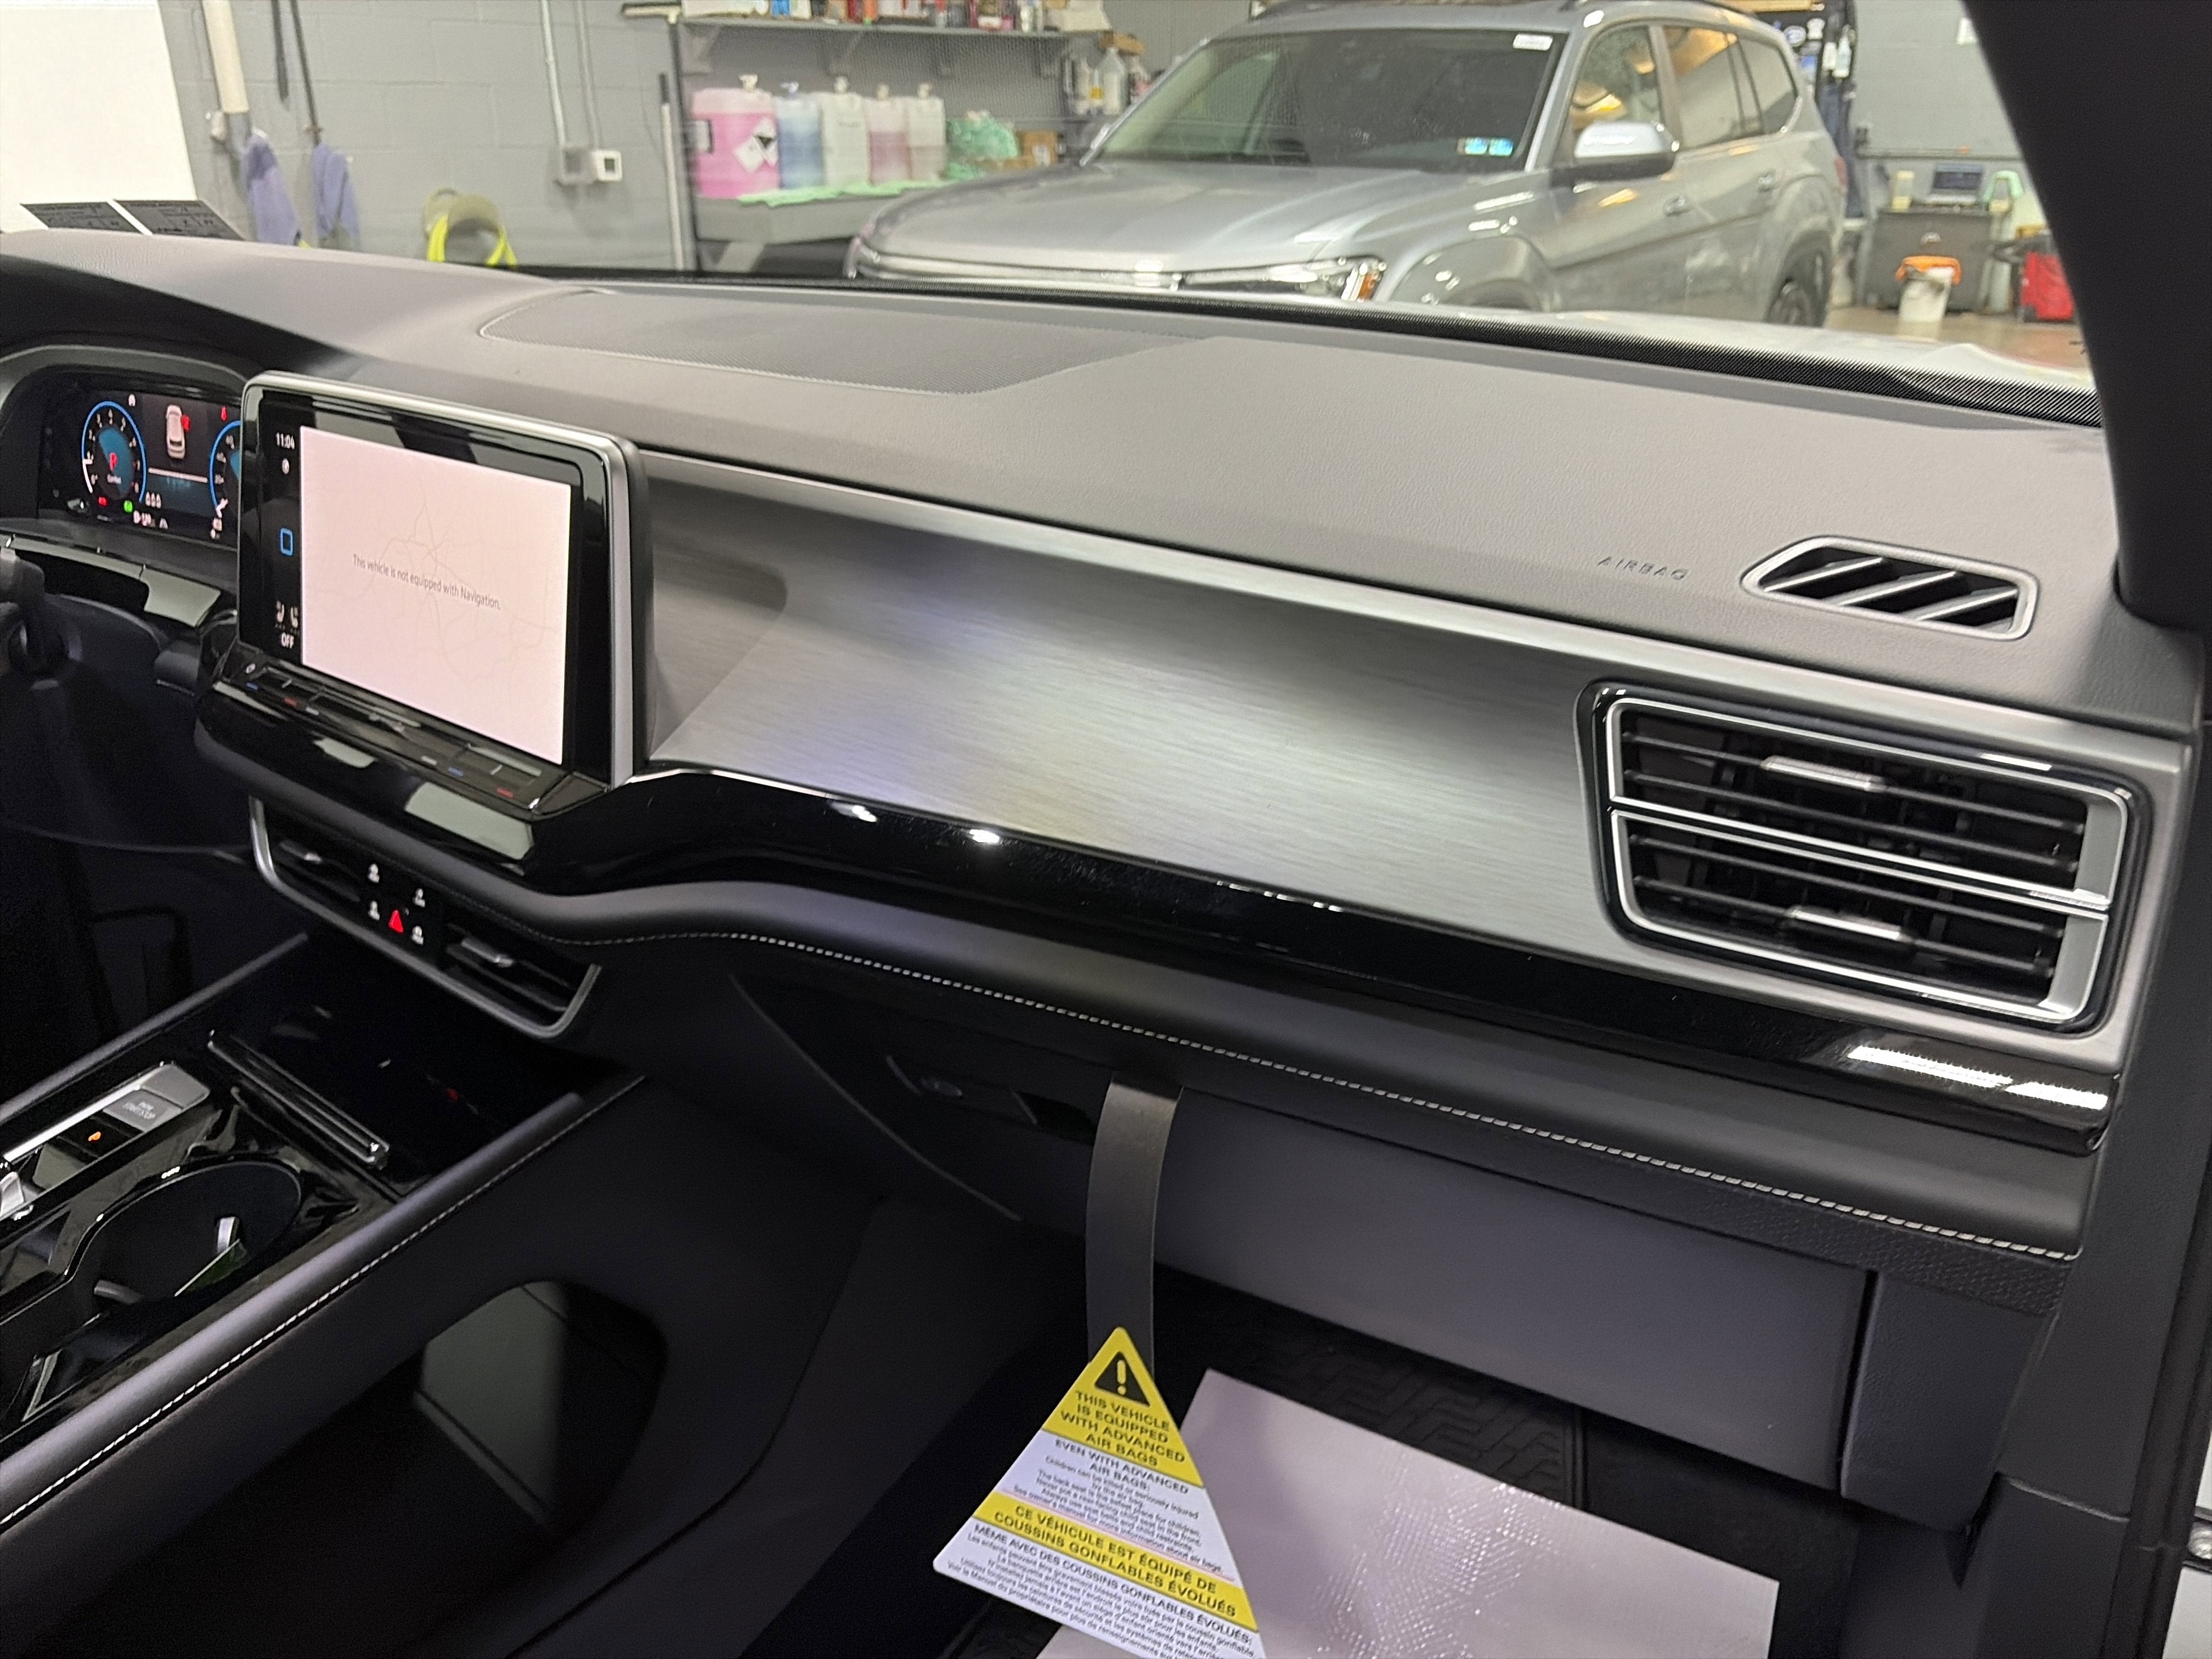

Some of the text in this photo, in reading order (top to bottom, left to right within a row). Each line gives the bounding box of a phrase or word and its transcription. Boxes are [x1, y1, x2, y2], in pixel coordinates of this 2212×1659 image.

[276, 432, 295, 449] 11:04
[353, 554, 501, 610] This vehicle is not equipped with Navigation.
[1598, 556, 1689, 580] AIRBAG
[281, 632, 294, 648] OFF
[1075, 1391, 1170, 1431] THIS VEHICLE
[1076, 1403, 1168, 1444] IS EQUIPPED
[1059, 1410, 1185, 1463] WITH ADVANCED
[1086, 1434, 1158, 1465] AIR BAGS
[1055, 1440, 1188, 1494] EVEN WITH ADVANCED
[1090, 1463, 1150, 1491] AIR BAGS:
[994, 1512, 1237, 1616] COUSSINS GONFLABLES ÉVOLUÉS
[1015, 1505, 1217, 1594] CE VÉHICULE EST ÉQUIPÉ DE
[974, 1525, 1253, 1644] MÊME AVEC DES COUSSINS GONFLABLES ÉVOLUÉS:
